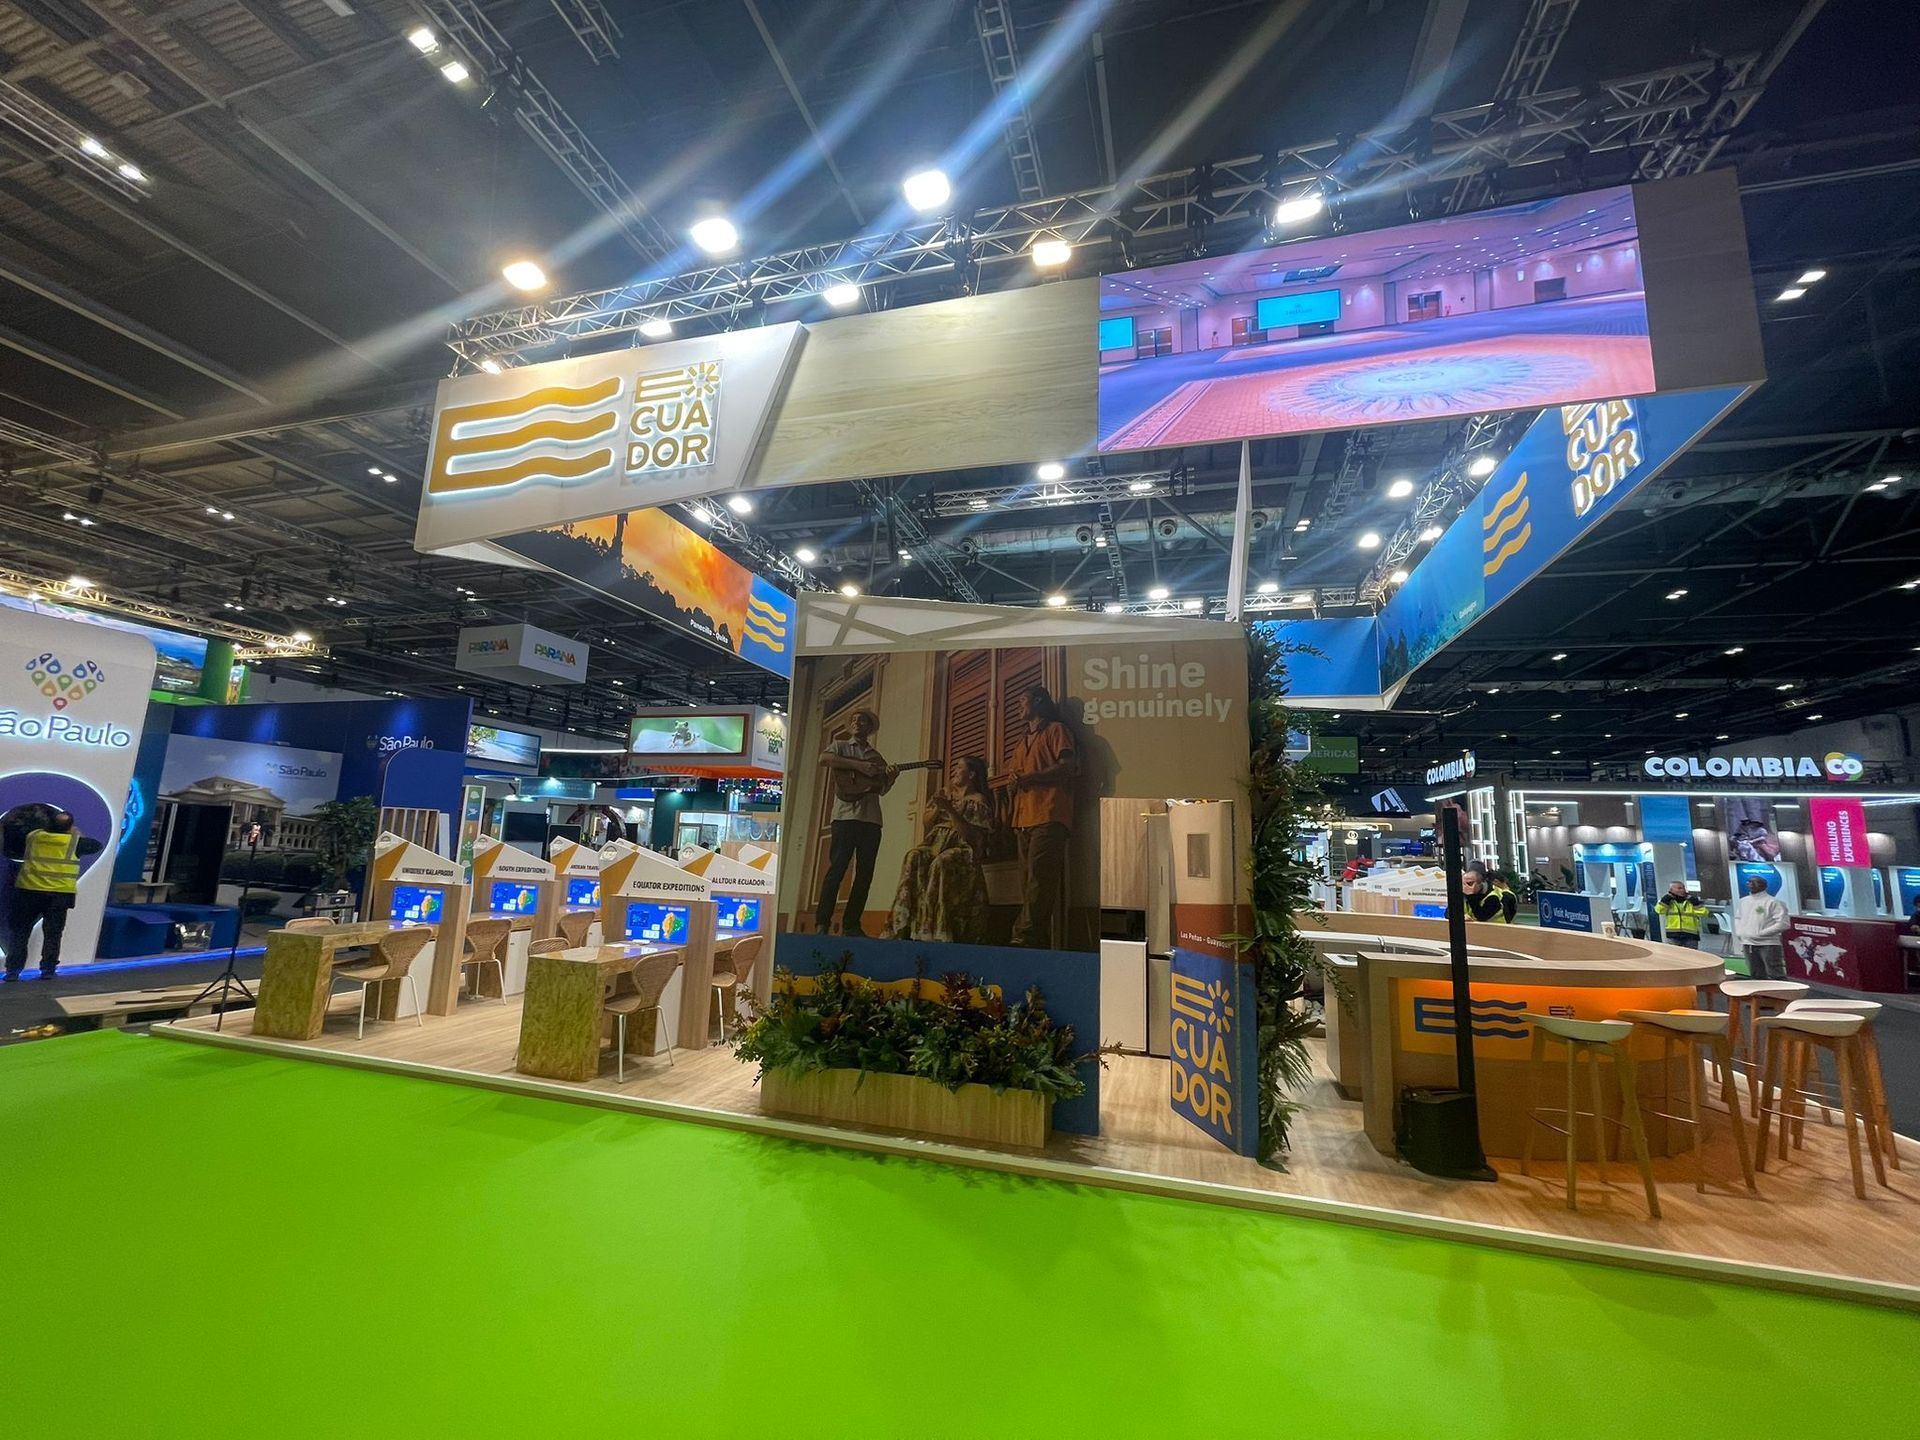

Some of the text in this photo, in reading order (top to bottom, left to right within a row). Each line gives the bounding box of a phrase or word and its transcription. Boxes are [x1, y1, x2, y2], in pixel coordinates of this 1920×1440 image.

[1083, 654, 1206, 691] Shine
[1082, 692, 1233, 725] genuinely
[0, 711, 130, 747] ão Paulo
[379, 736, 402, 750] São
[278, 764, 327, 778] São Paulo
[1426, 758, 1465, 785] COLOMBIA
[1644, 756, 1822, 777] COLOMBIA
[1826, 820, 1840, 862] THRILLING
[1838, 810, 1854, 863] EXPERIENCES
[632, 880, 705, 893] EQUATOR EXPEDITIONS
[711, 877, 766, 887] ALLTOUR ECUADOR
